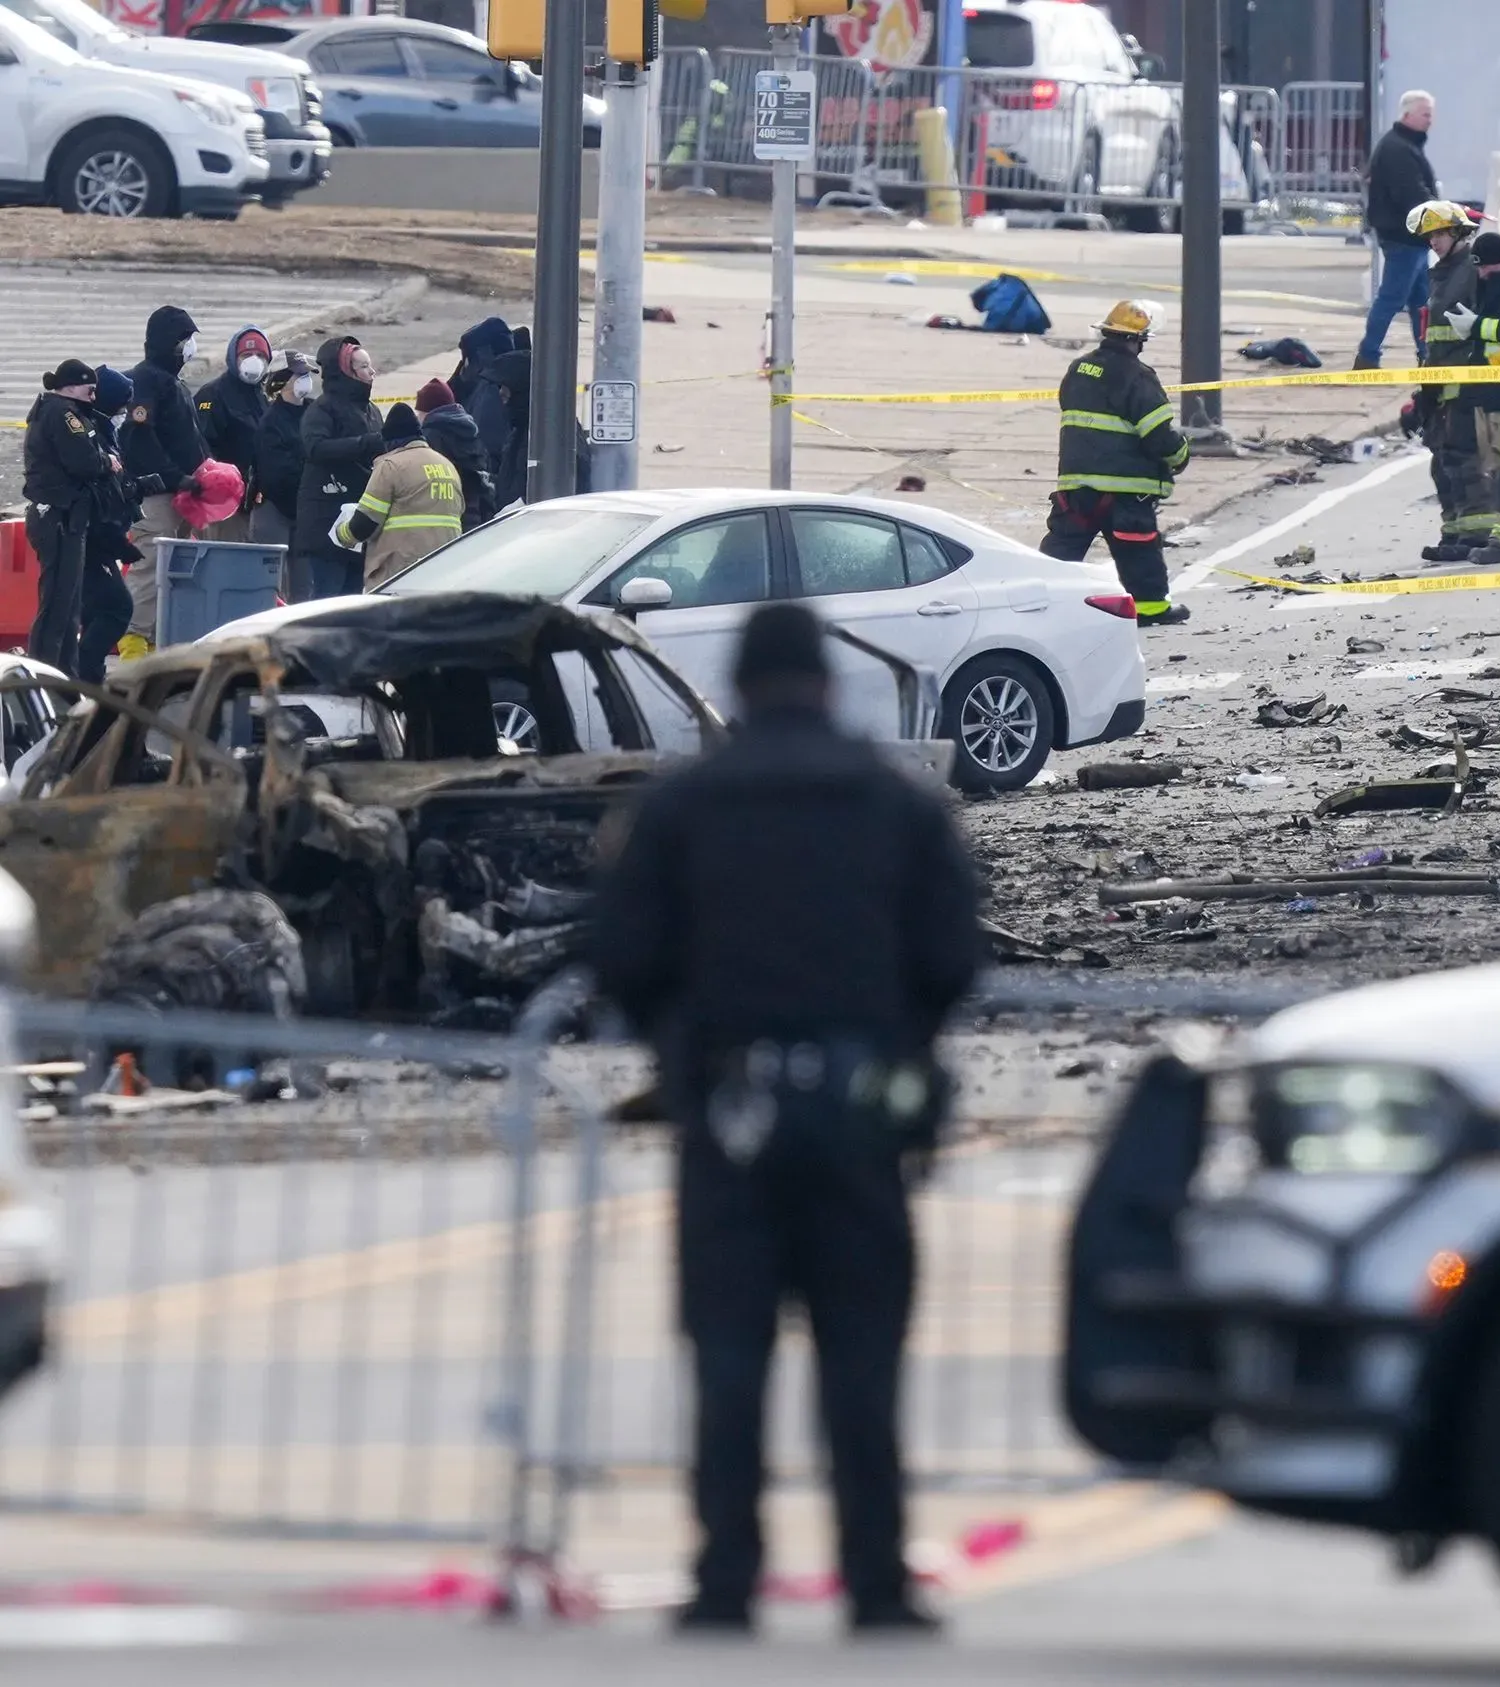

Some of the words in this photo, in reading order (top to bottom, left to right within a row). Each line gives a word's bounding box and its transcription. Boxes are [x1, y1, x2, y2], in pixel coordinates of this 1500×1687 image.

[758, 92, 778, 108] 70
[758, 110, 777, 125] 77
[758, 128, 776, 139] 400
[431, 482, 454, 500] FMO
